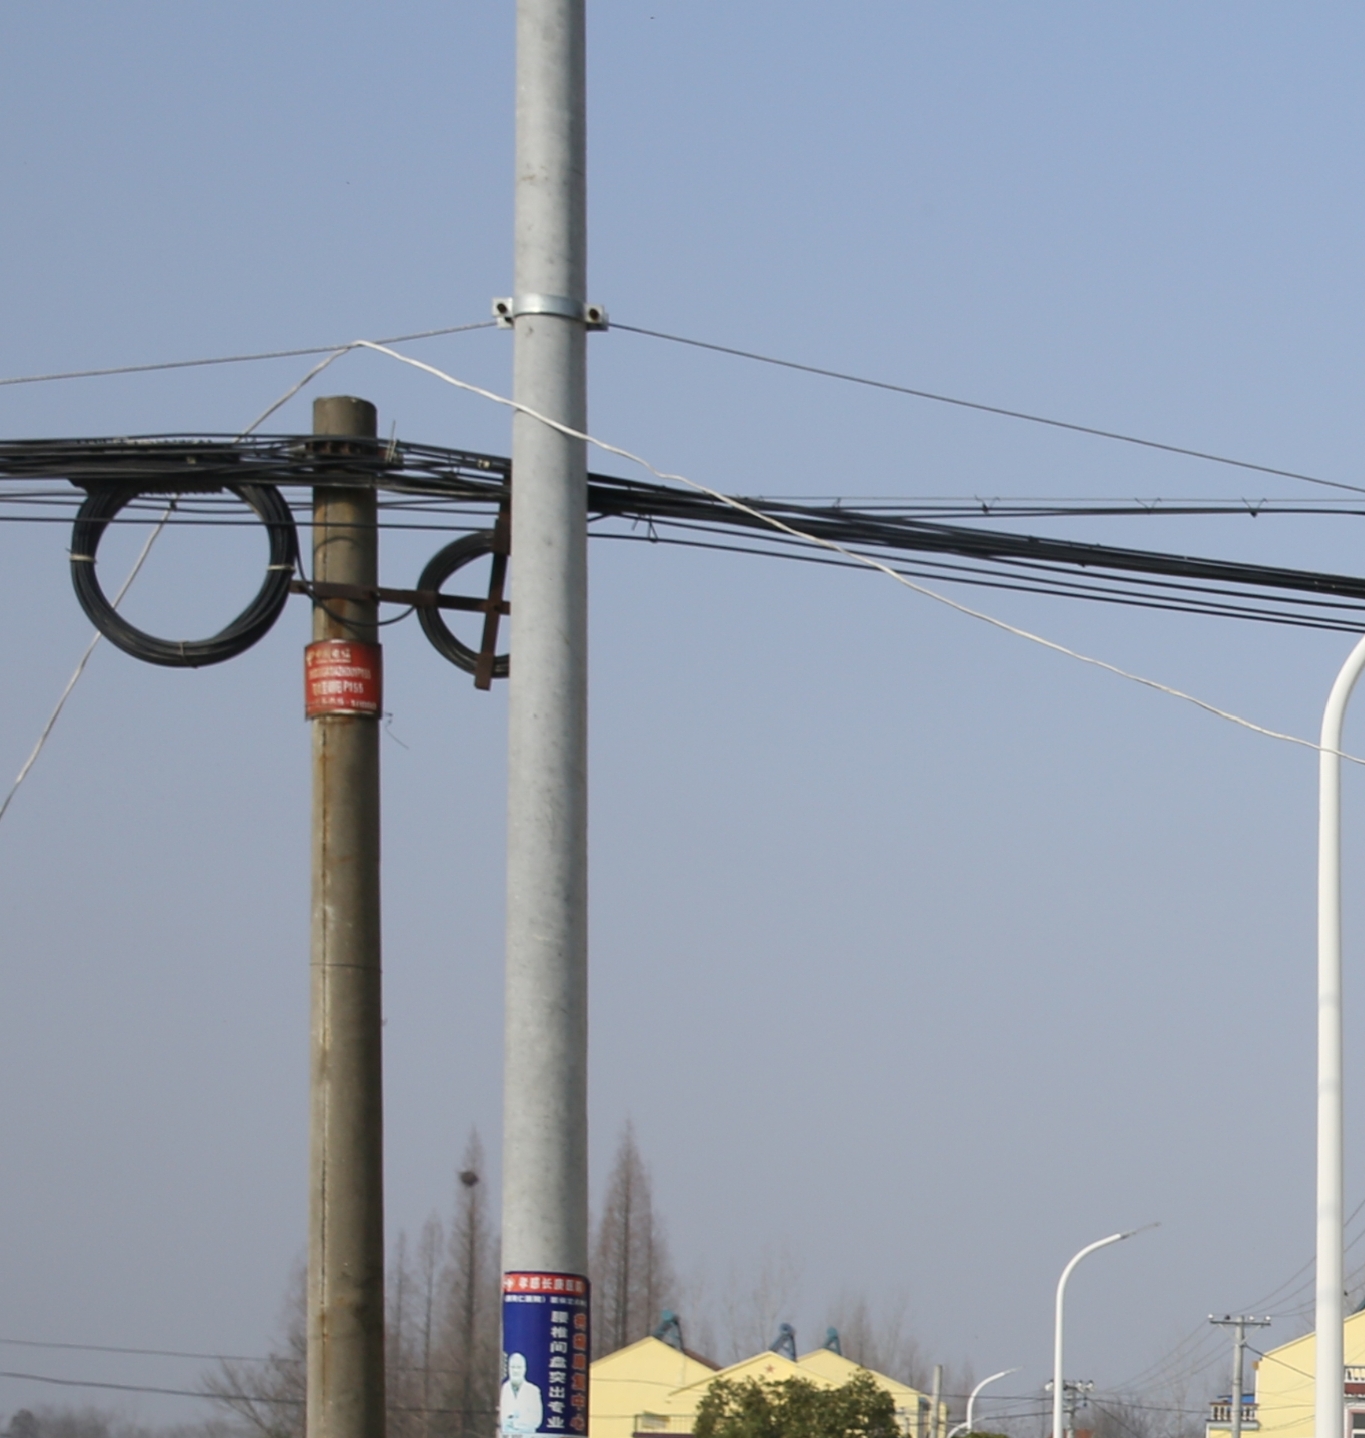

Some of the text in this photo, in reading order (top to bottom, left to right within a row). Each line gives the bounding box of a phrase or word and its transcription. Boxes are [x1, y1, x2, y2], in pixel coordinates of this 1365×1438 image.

[546, 1310, 569, 1428] 腰椎间盘突出专业
